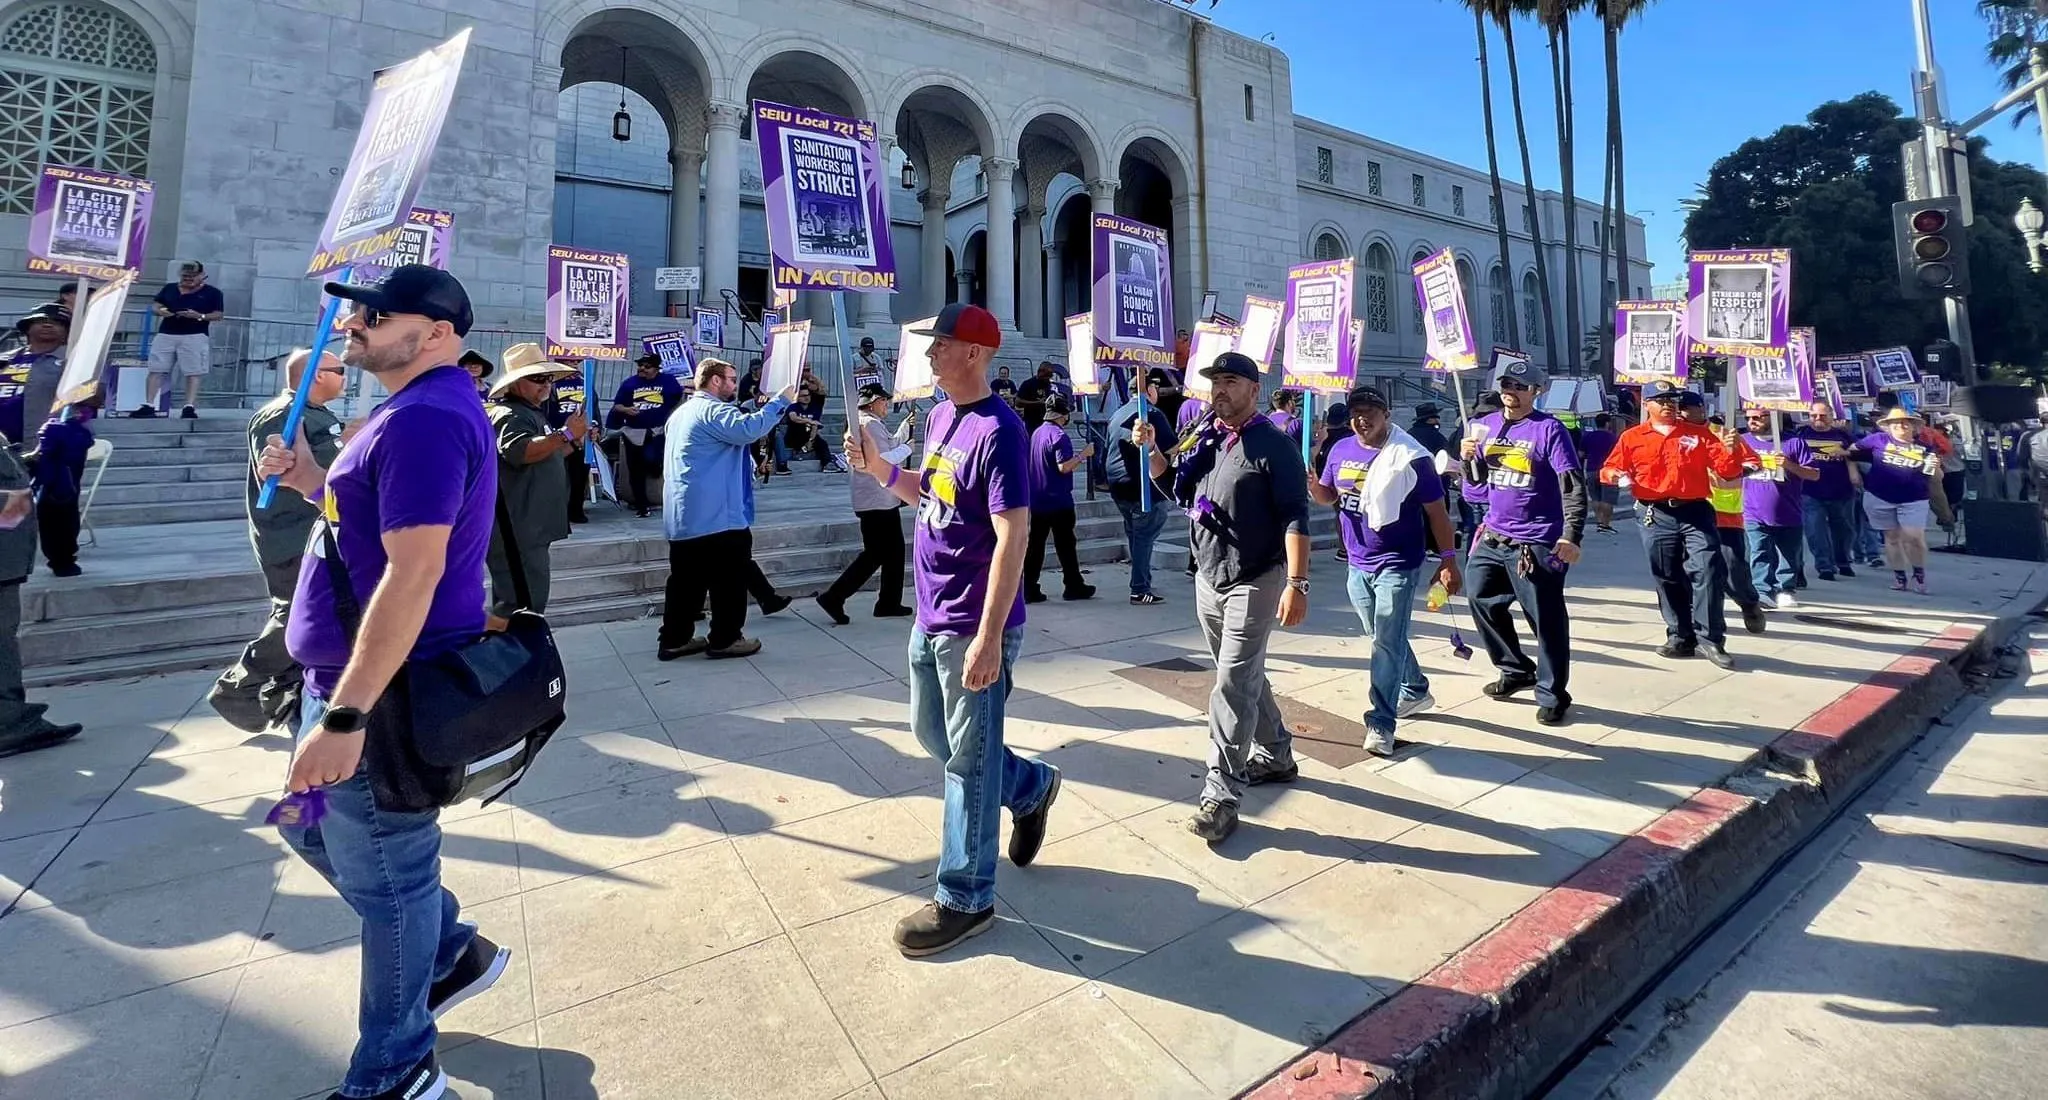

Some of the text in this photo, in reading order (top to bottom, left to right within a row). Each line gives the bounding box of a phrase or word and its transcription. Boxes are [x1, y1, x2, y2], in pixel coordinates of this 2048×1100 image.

[759, 107, 854, 135] SEIU Local 721
[373, 122, 421, 157] TRASH!
[793, 138, 852, 162] SANITATION
[795, 154, 854, 177] WORKERS ON
[44, 167, 133, 188] SEIU Local 721
[797, 169, 857, 197] STRIKE!
[67, 188, 123, 205] LA CITY
[67, 198, 122, 212] WORKERS
[65, 210, 119, 230] TAKE
[409, 211, 432, 223] 721
[62, 223, 116, 239] ACTION
[1095, 217, 1155, 240] SEIU Local 721
[310, 250, 331, 272] IN
[329, 227, 402, 267] ACTION!
[407, 243, 420, 254] ON
[28, 258, 53, 271] IN
[550, 249, 573, 258] SEIU
[574, 252, 597, 261] Local
[599, 255, 614, 265] 721
[1691, 253, 1769, 262] SEIU Local 721
[570, 268, 611, 283] LA CITY
[778, 267, 895, 288] IN ACTION!
[1305, 267, 1324, 276] Local
[1325, 265, 1339, 273] 721
[570, 279, 611, 292] DON'T BE
[569, 289, 610, 304] TRASH!
[1123, 295, 1154, 313] ROMPIÓ
[1711, 298, 1763, 309] RESPECT
[1124, 310, 1155, 328] LA LEY!
[1299, 306, 1332, 322] STRIKE!
[1632, 337, 1669, 346] RESPECT
[548, 345, 627, 358] IN ACTION!
[1095, 346, 1175, 365] IN ACTION!
[1690, 343, 1786, 357] IN ACTION!
[1754, 359, 1786, 372] ULP
[1616, 374, 1629, 383] IN
[1756, 371, 1789, 380] STRIKE
[1743, 401, 1812, 410] IN ACTION!
[1882, 455, 1923, 468] SEIU
